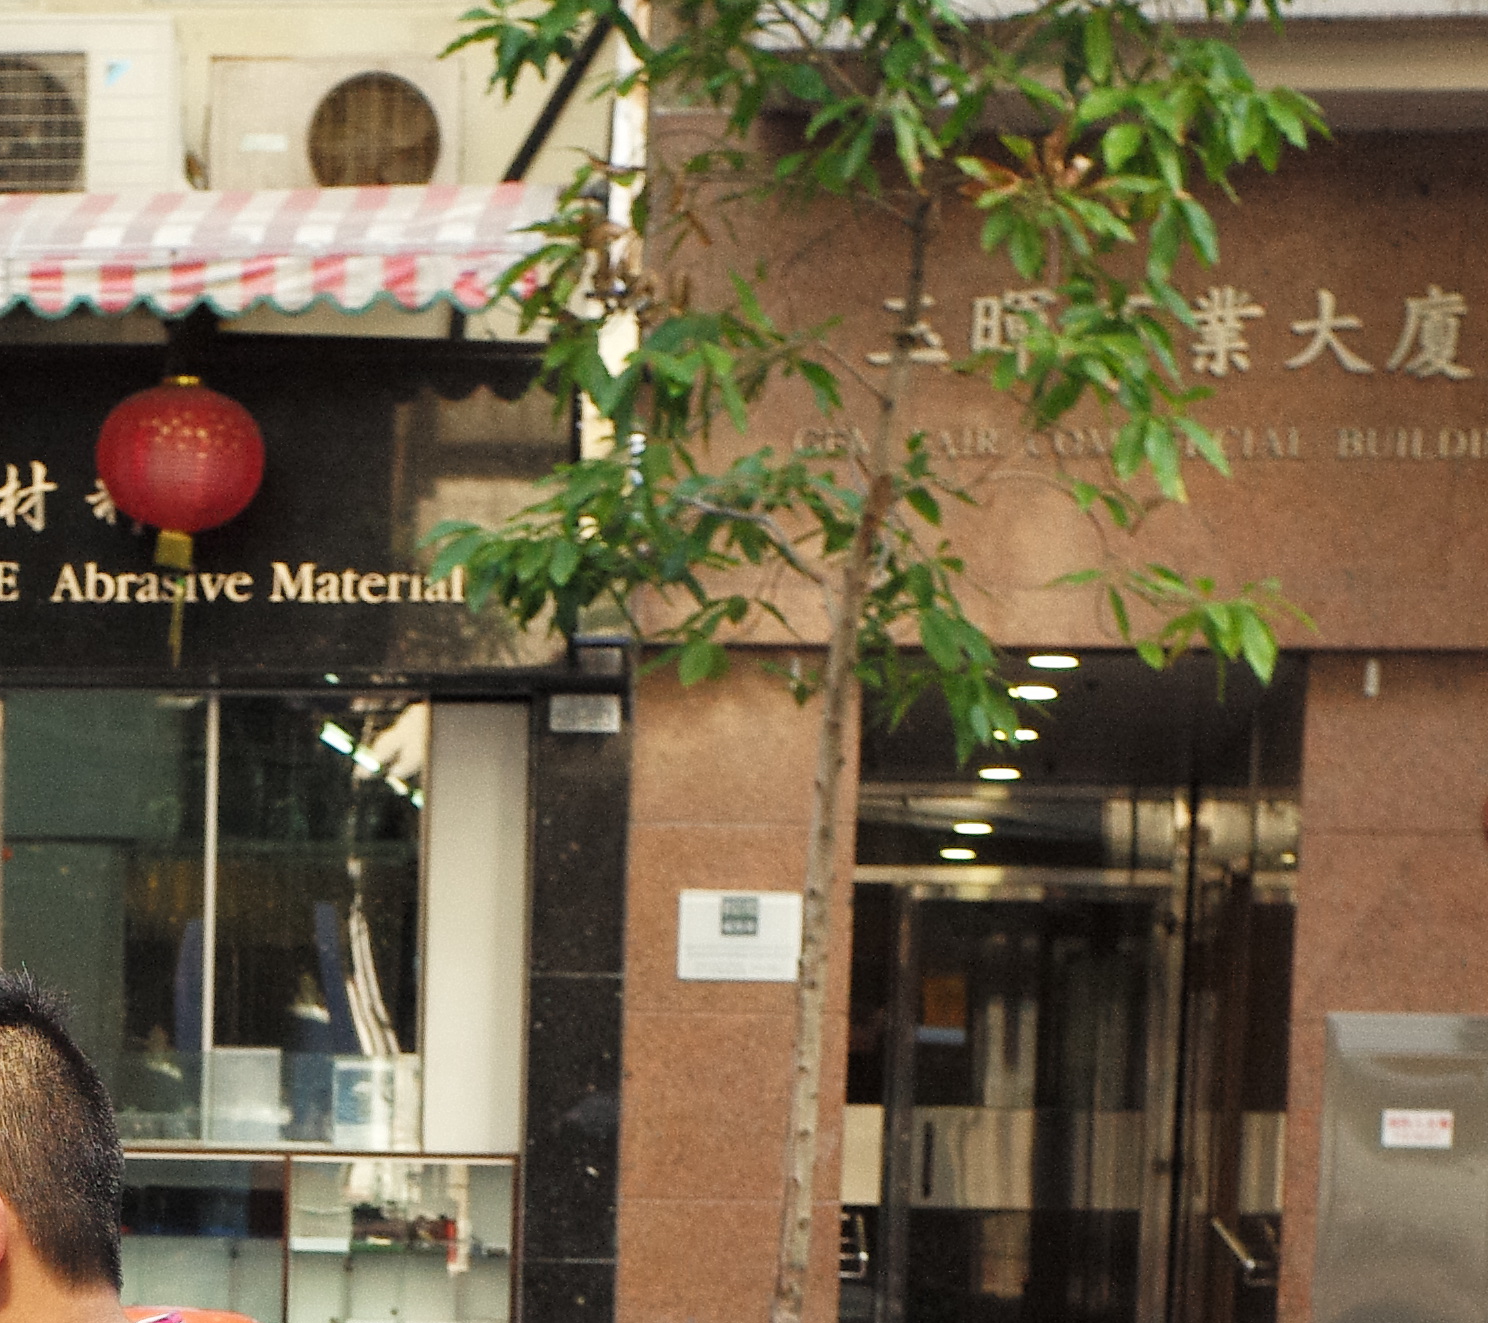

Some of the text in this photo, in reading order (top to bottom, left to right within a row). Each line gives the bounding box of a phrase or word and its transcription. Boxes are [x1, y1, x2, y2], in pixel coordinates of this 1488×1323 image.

[866, 286, 1475, 379] 玉暉業大廈
[50, 561, 253, 603] Abrasive
